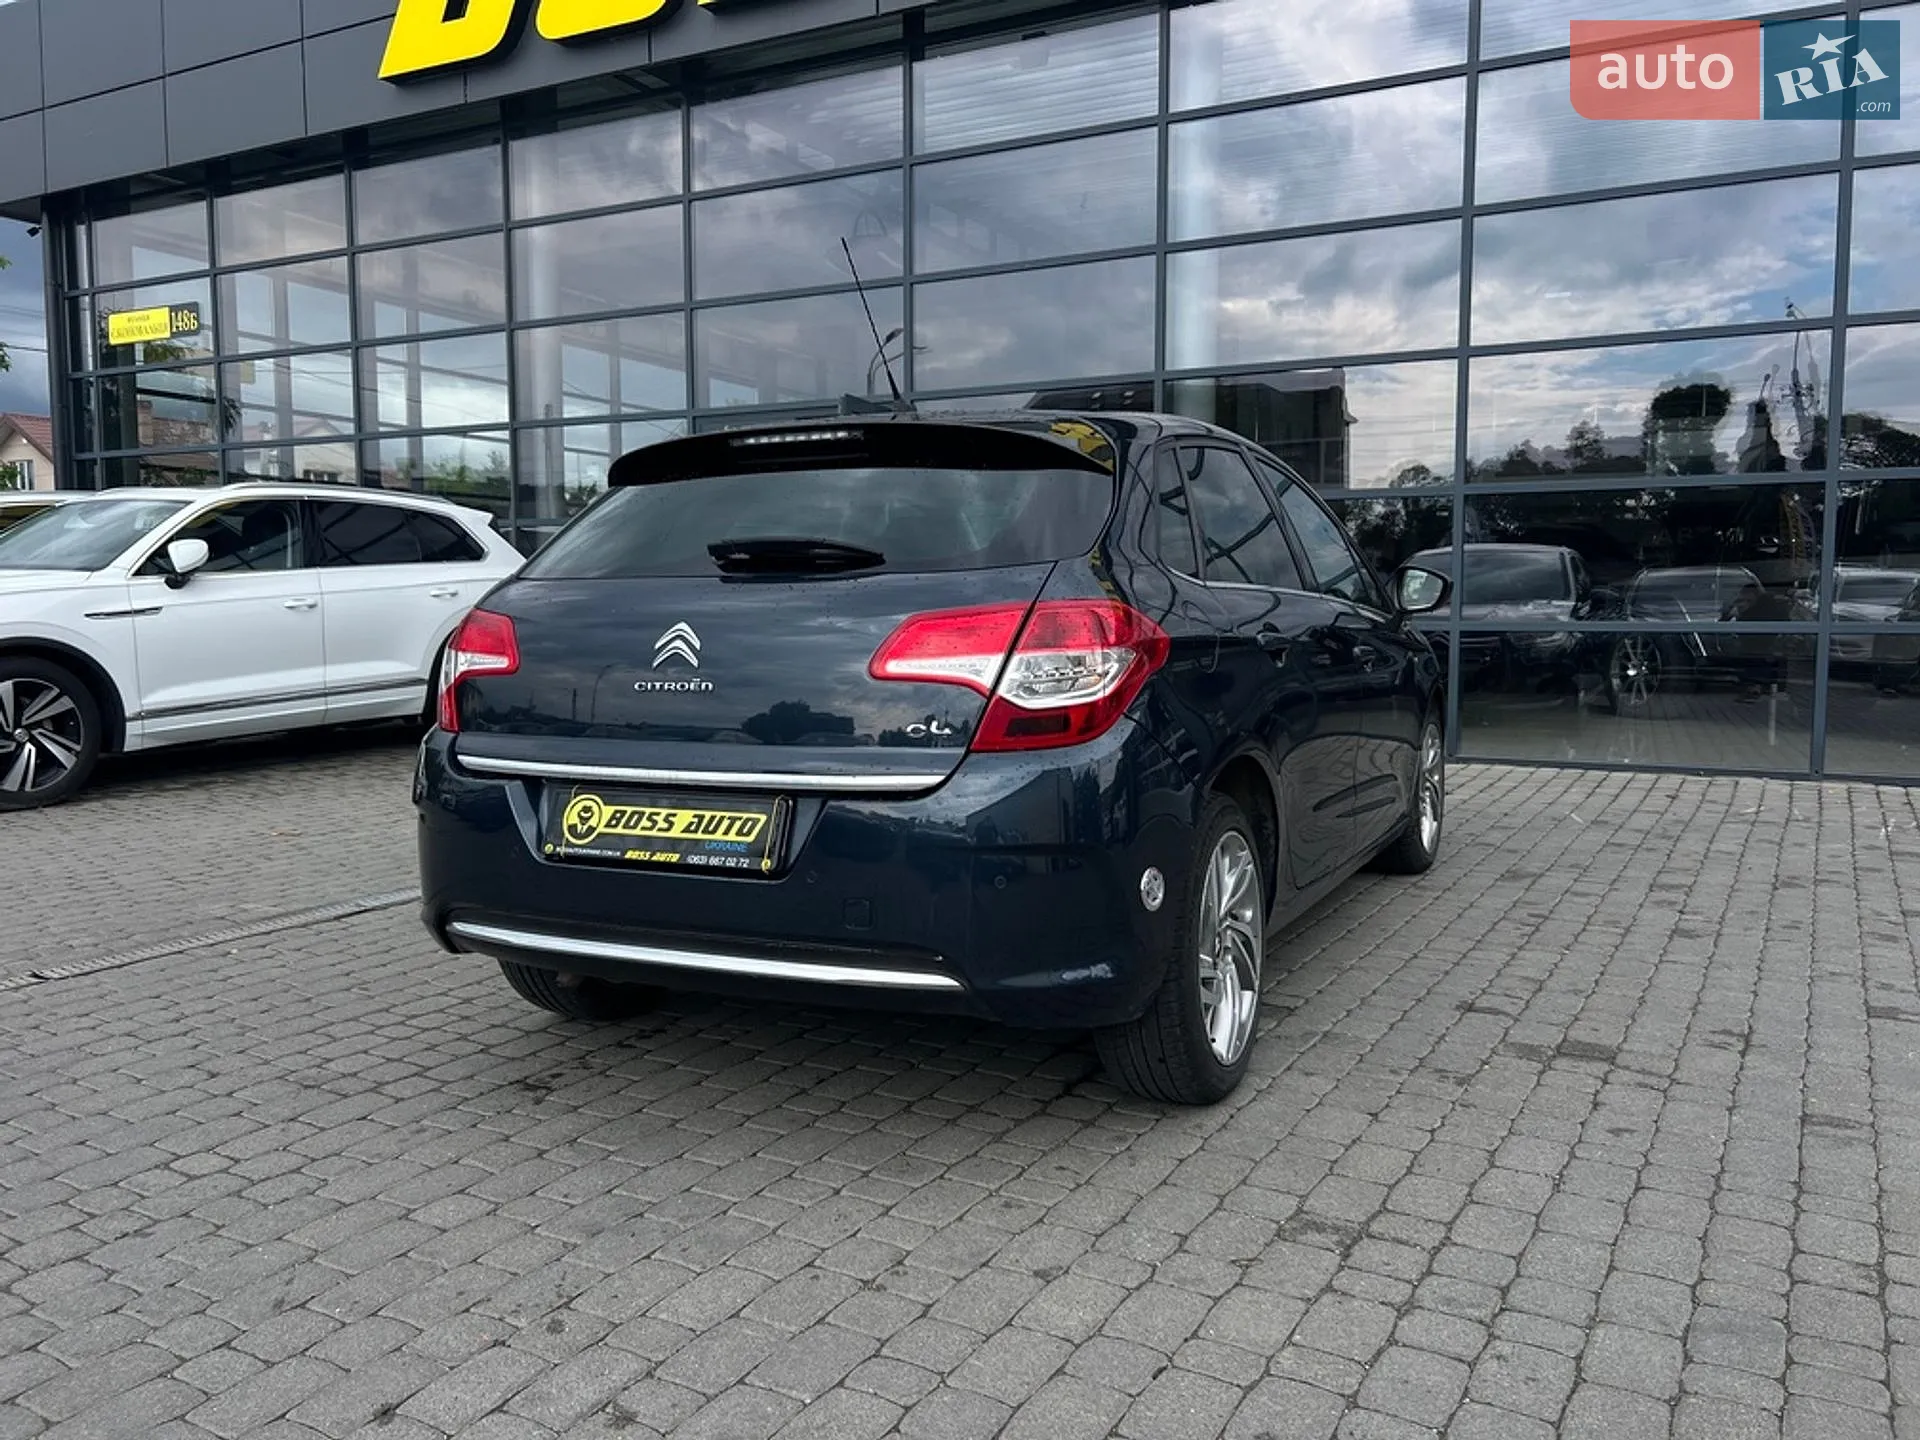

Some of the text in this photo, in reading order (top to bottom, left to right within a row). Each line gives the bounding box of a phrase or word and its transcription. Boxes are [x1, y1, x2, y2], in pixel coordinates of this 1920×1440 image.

[604, 809, 761, 838] BOSS AUTO
[704, 840, 748, 853] UKRAINE
[624, 850, 651, 860] BOSS
[652, 852, 681, 863] AUTO
